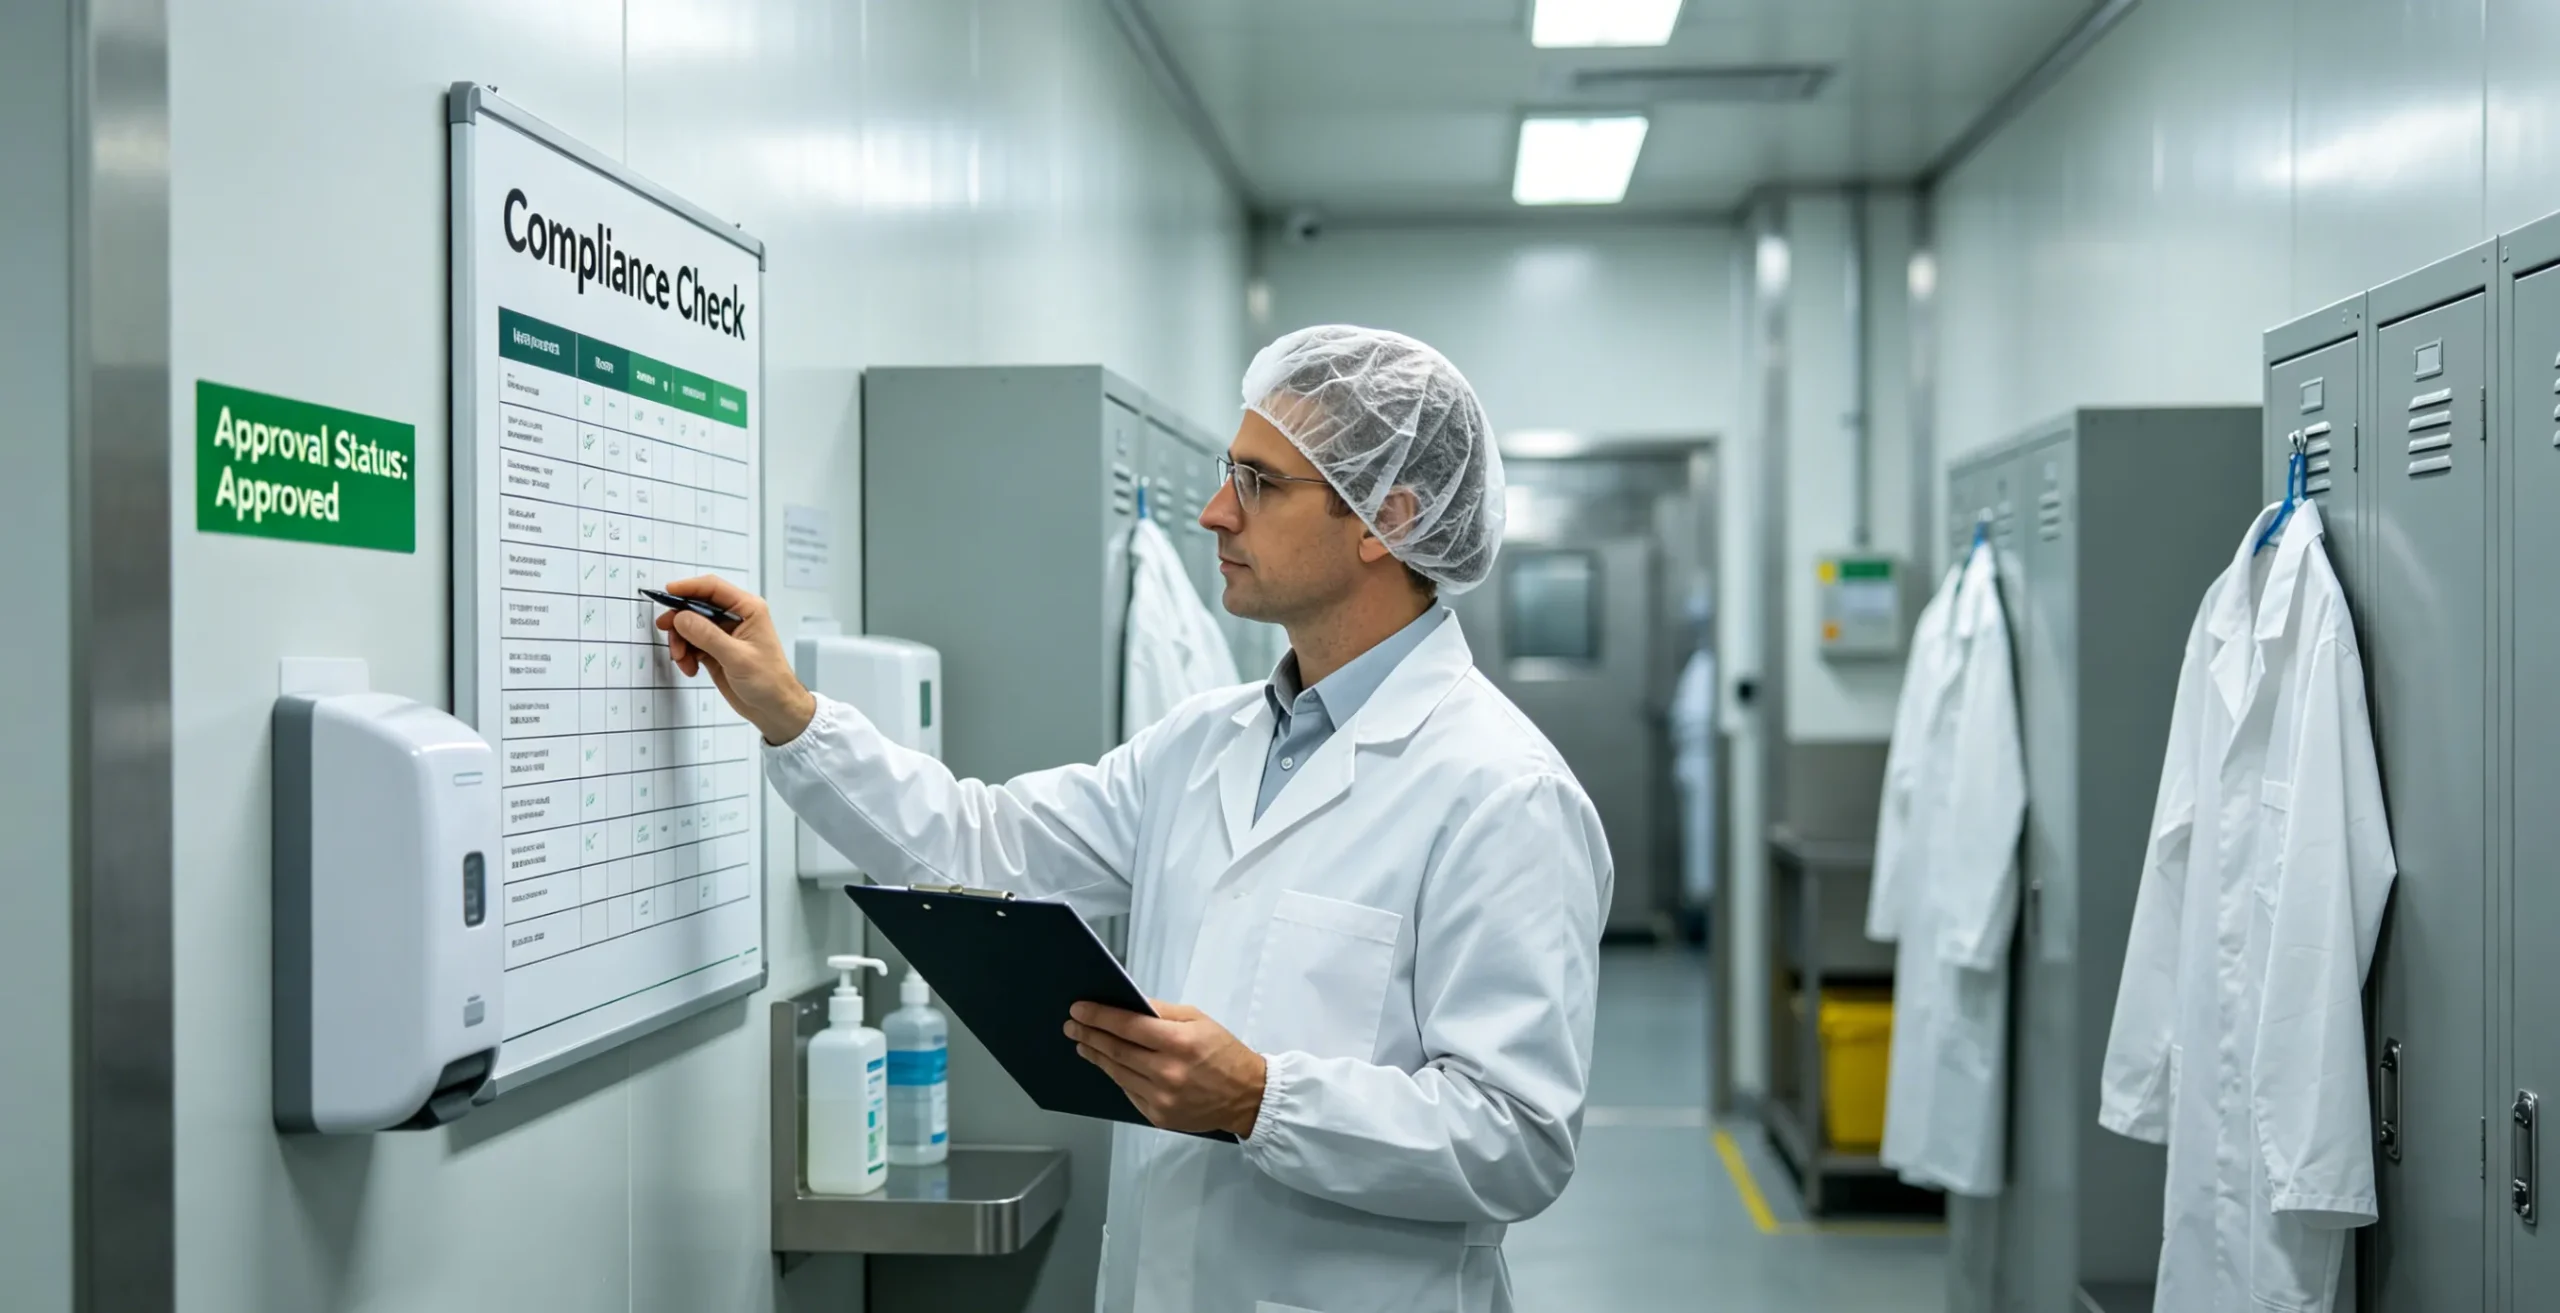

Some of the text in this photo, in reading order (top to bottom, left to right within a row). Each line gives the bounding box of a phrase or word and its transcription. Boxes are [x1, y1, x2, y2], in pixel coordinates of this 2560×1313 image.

[504, 188, 746, 341] Compliance Check
[214, 405, 408, 480] Approval Status:
[215, 465, 340, 524] Approved
